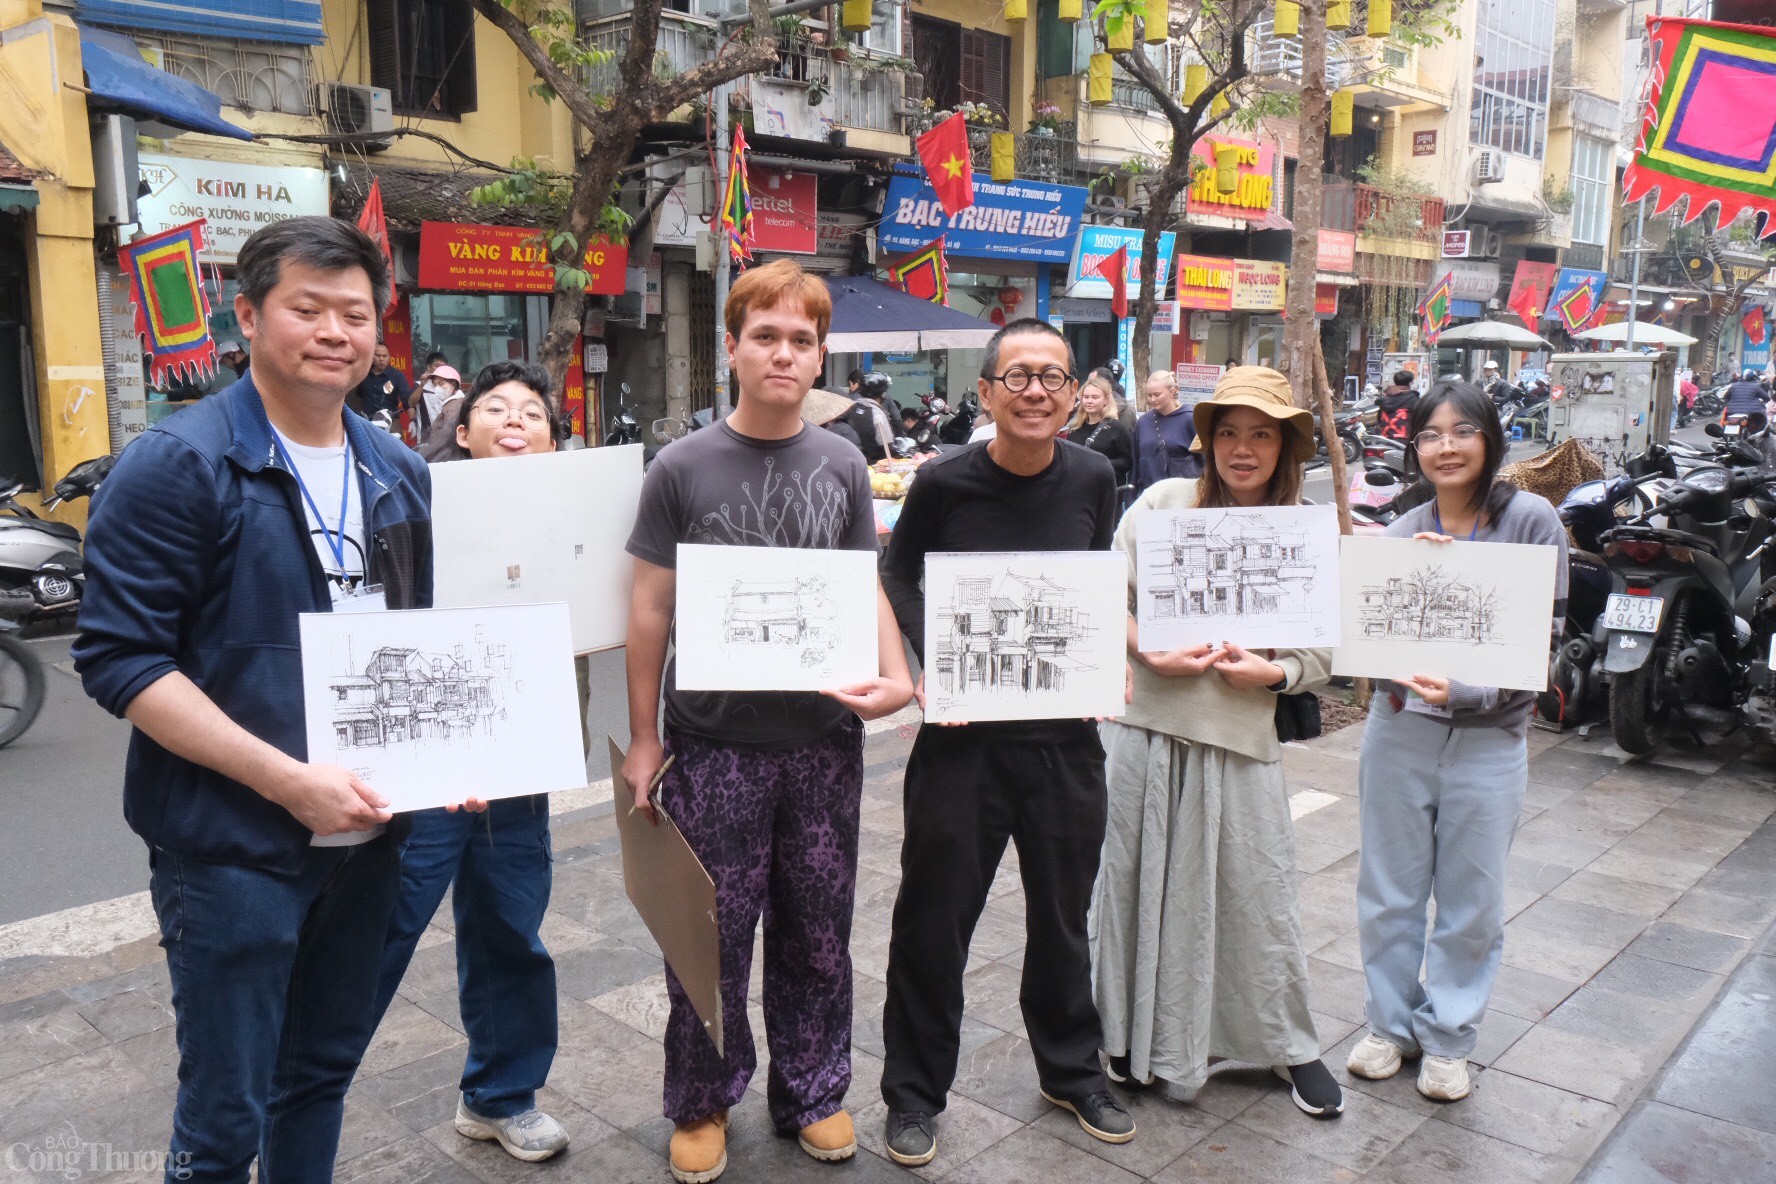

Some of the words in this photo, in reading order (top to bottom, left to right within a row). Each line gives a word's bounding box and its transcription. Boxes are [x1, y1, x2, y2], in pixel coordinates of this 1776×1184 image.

[256, 181, 293, 203] HÀ
[980, 183, 1005, 195] TRANG
[1021, 188, 1046, 200] TRUNG
[169, 202, 204, 217] CÔNG
[208, 204, 250, 221] XƯỞNG
[895, 197, 943, 230] BẠC
[948, 205, 1022, 234] TRUNG
[1022, 205, 1071, 239] HIẾU
[765, 217, 795, 227] telecom
[456, 227, 476, 235] CÔNG
[1094, 233, 1121, 249] MISU
[448, 238, 501, 261] VÀNG
[450, 267, 466, 275] MUA
[527, 269, 545, 277] VÀNG
[1184, 264, 1208, 287] THÁI
[1208, 269, 1232, 289] LONG
[1260, 272, 1281, 285] LONG
[388, 320, 404, 334] MUA
[1743, 351, 1769, 365] TRANG
[117, 376, 140, 387] SIZE
[567, 384, 583, 400] VÀNG
[1615, 598, 1653, 613] 29-C1
[1607, 614, 1656, 630] 494.23
